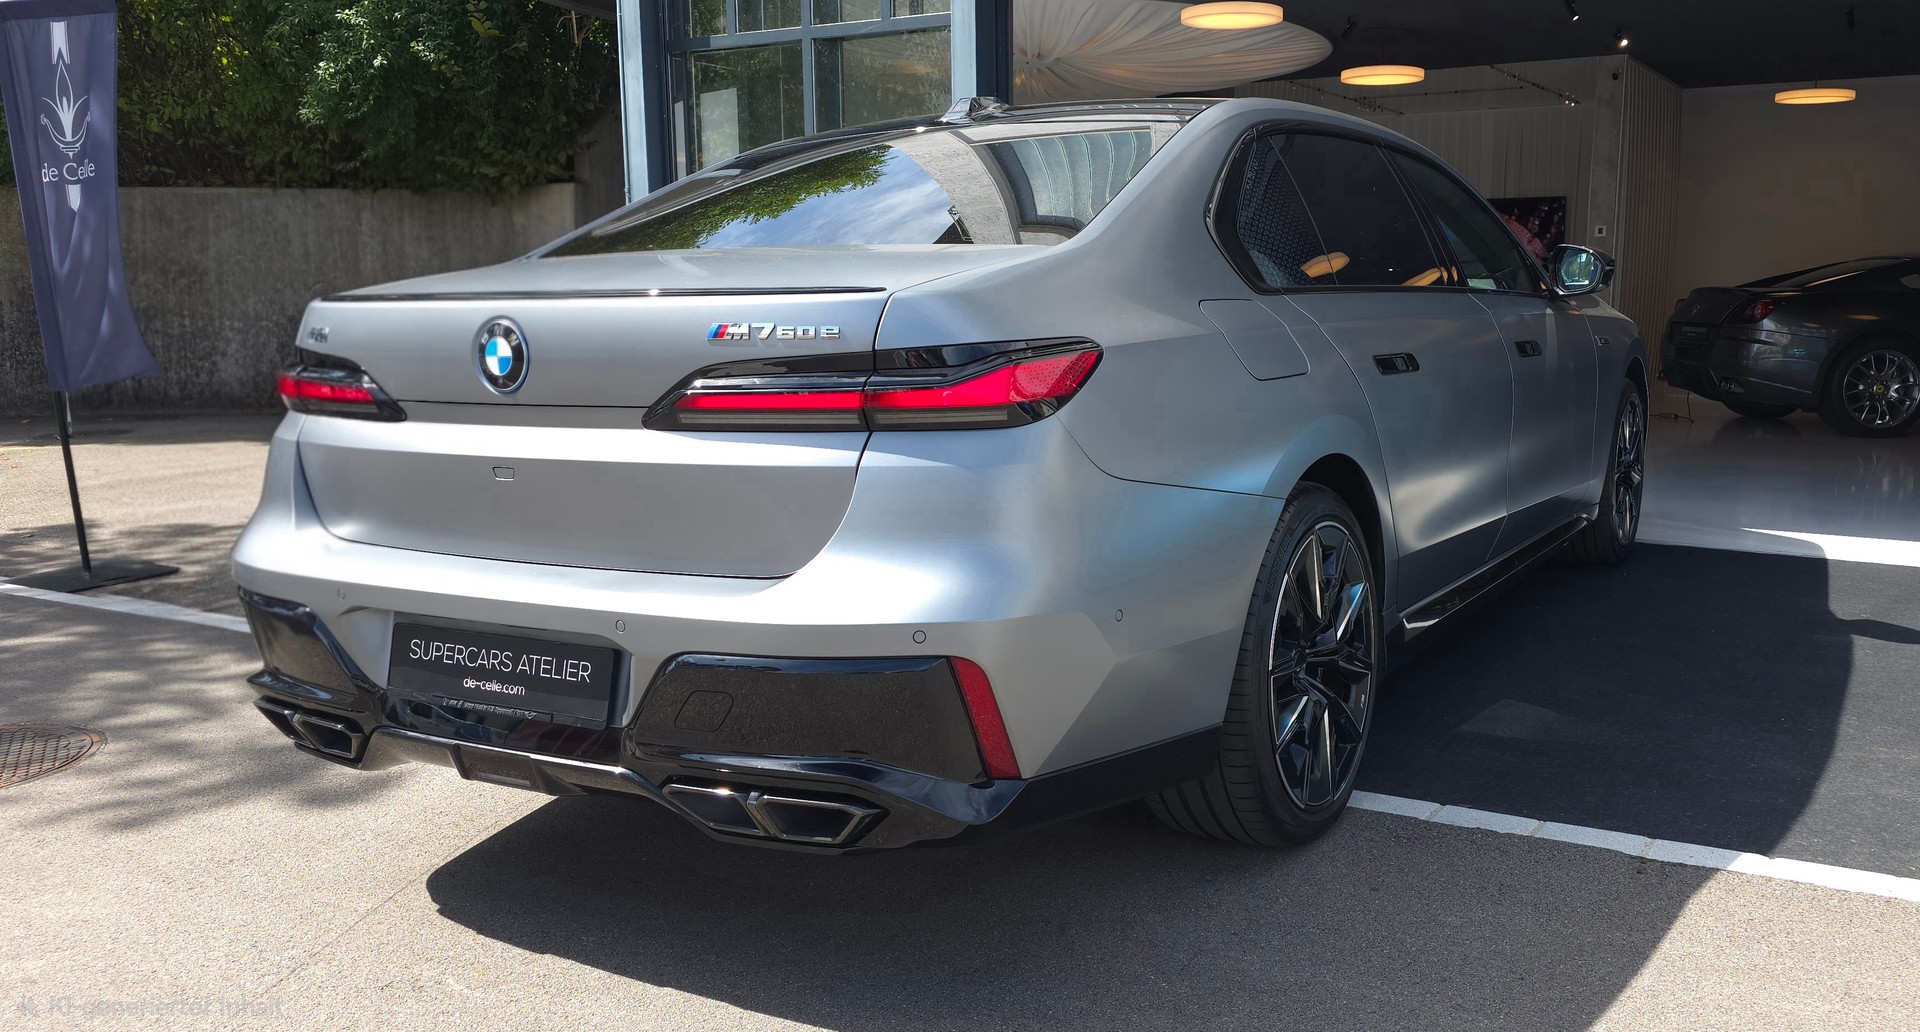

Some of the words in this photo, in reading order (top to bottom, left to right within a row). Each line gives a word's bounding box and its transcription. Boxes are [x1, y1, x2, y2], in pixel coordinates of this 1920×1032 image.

[42, 163, 59, 182] de
[481, 325, 520, 346] BMW
[409, 639, 513, 672] SUPERCARS
[516, 654, 592, 683] ATELIER
[463, 676, 526, 696] de-celle.com
